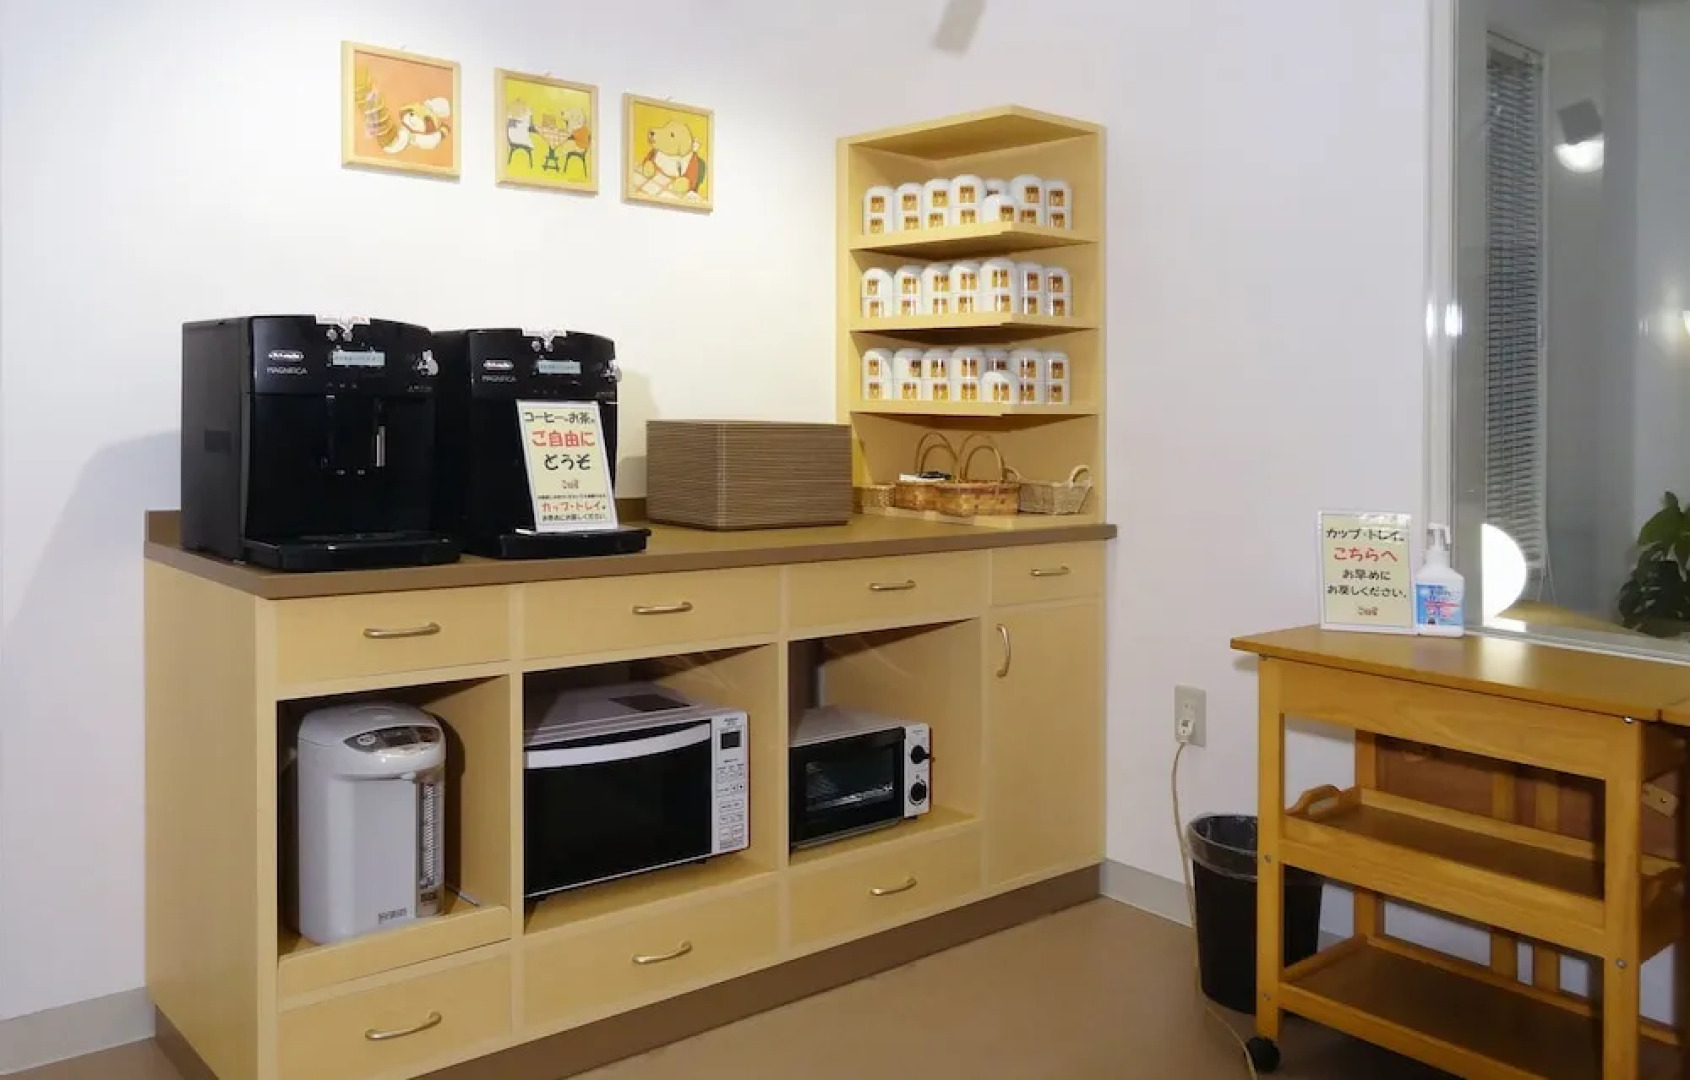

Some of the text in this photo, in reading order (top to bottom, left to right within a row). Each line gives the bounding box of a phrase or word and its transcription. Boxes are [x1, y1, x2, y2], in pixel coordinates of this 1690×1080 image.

[532, 431, 595, 446] ご自由に
[1333, 547, 1398, 562] こちらへ
[1342, 569, 1391, 581] お早めに
